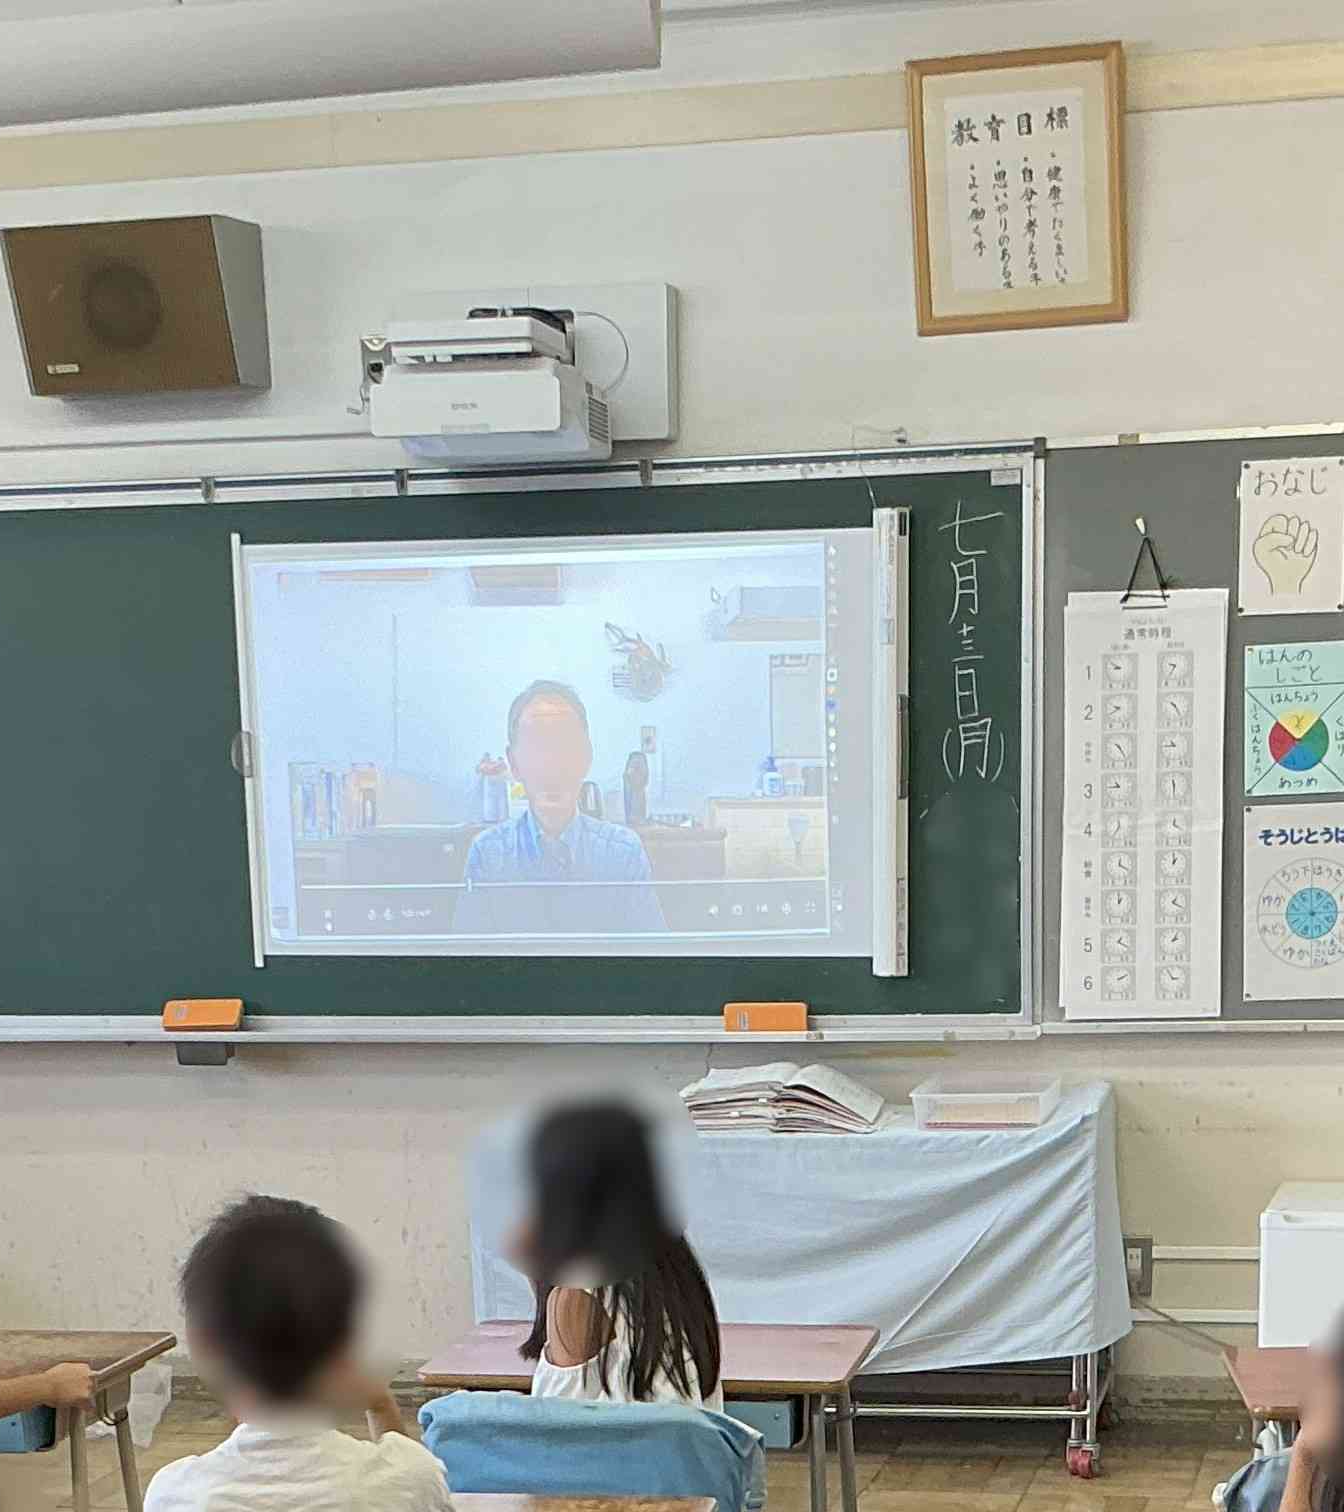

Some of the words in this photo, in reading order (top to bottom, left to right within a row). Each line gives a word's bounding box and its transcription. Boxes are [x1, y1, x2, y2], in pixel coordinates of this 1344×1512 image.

[1253, 466, 1328, 497] おなじ
[1258, 648, 1313, 665] はんの
[1086, 665, 1092, 681] 1
[1276, 664, 1323, 683] しごと
[1270, 690, 1319, 704] はんちょう
[1084, 704, 1094, 720] 2
[1083, 783, 1093, 799] 3
[1083, 822, 1092, 837] 4
[1083, 937, 1093, 953] 5
[1083, 975, 1093, 990] 6
